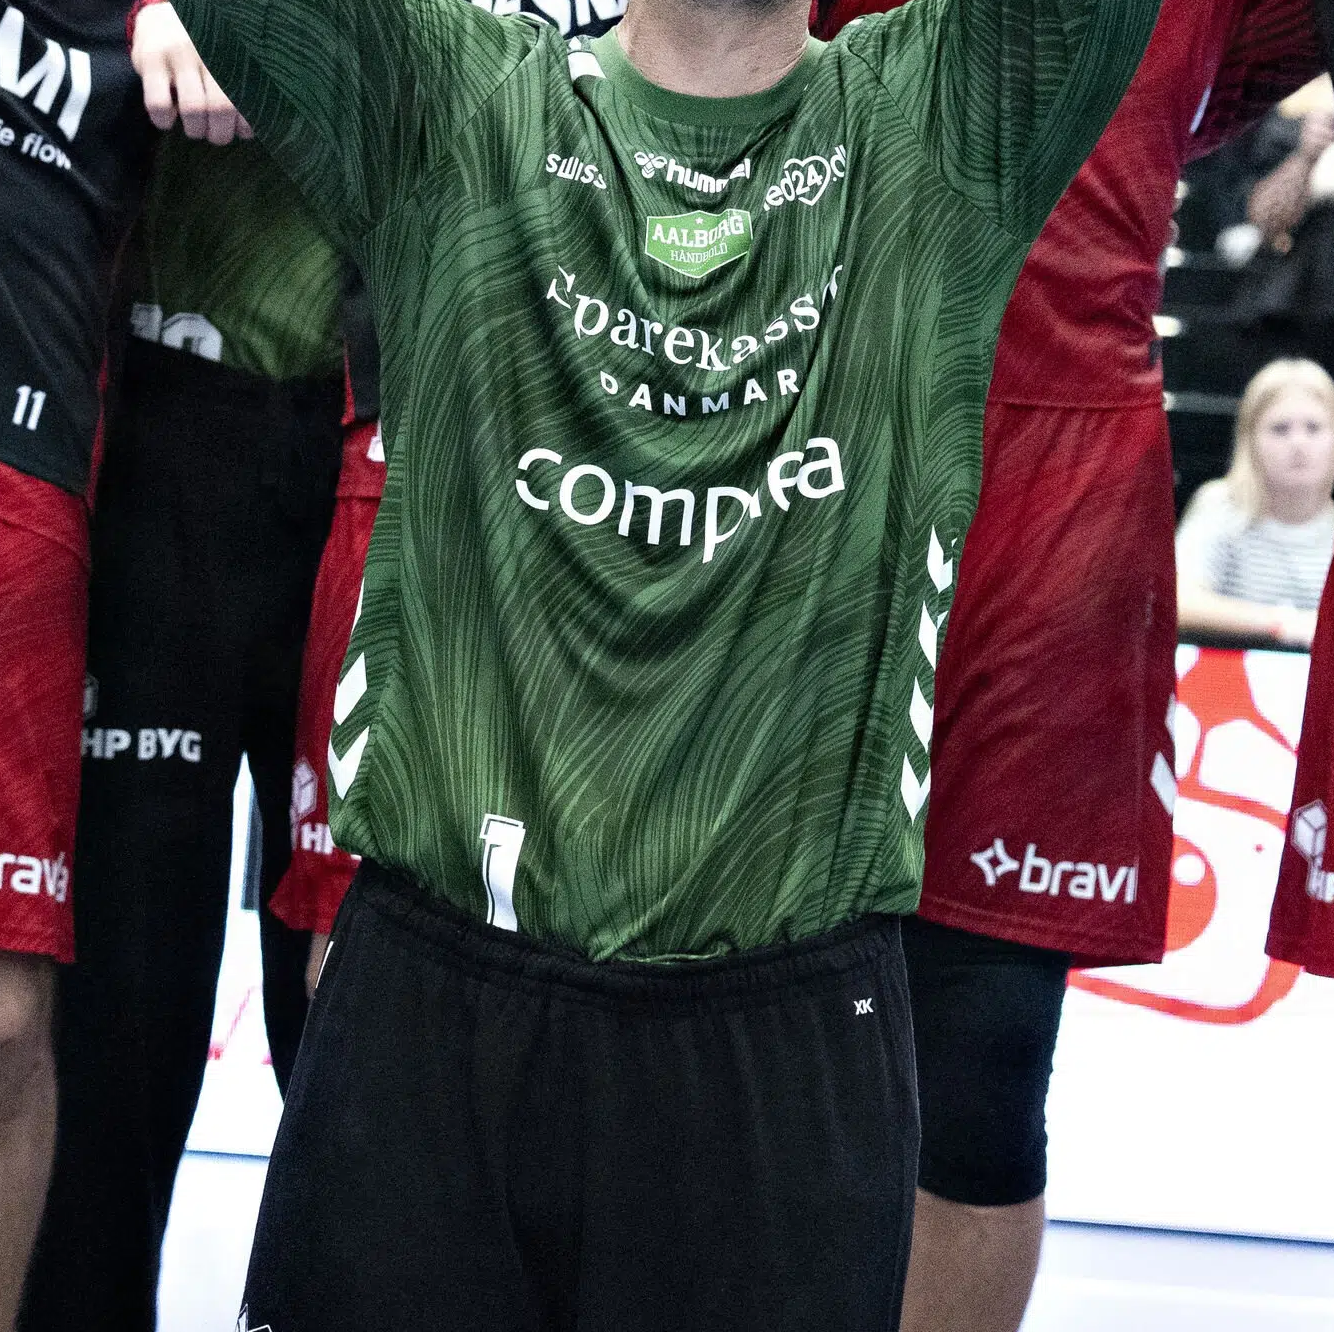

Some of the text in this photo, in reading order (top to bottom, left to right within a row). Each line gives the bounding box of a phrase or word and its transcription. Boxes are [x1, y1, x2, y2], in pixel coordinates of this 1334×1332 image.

[763, 144, 847, 212] ed24.d
[651, 214, 745, 249] AALBORG
[12, 384, 47, 431] 11
[80, 727, 202, 763] HP BYG
[479, 813, 526, 932] 1
[1019, 843, 1140, 905] bravi
